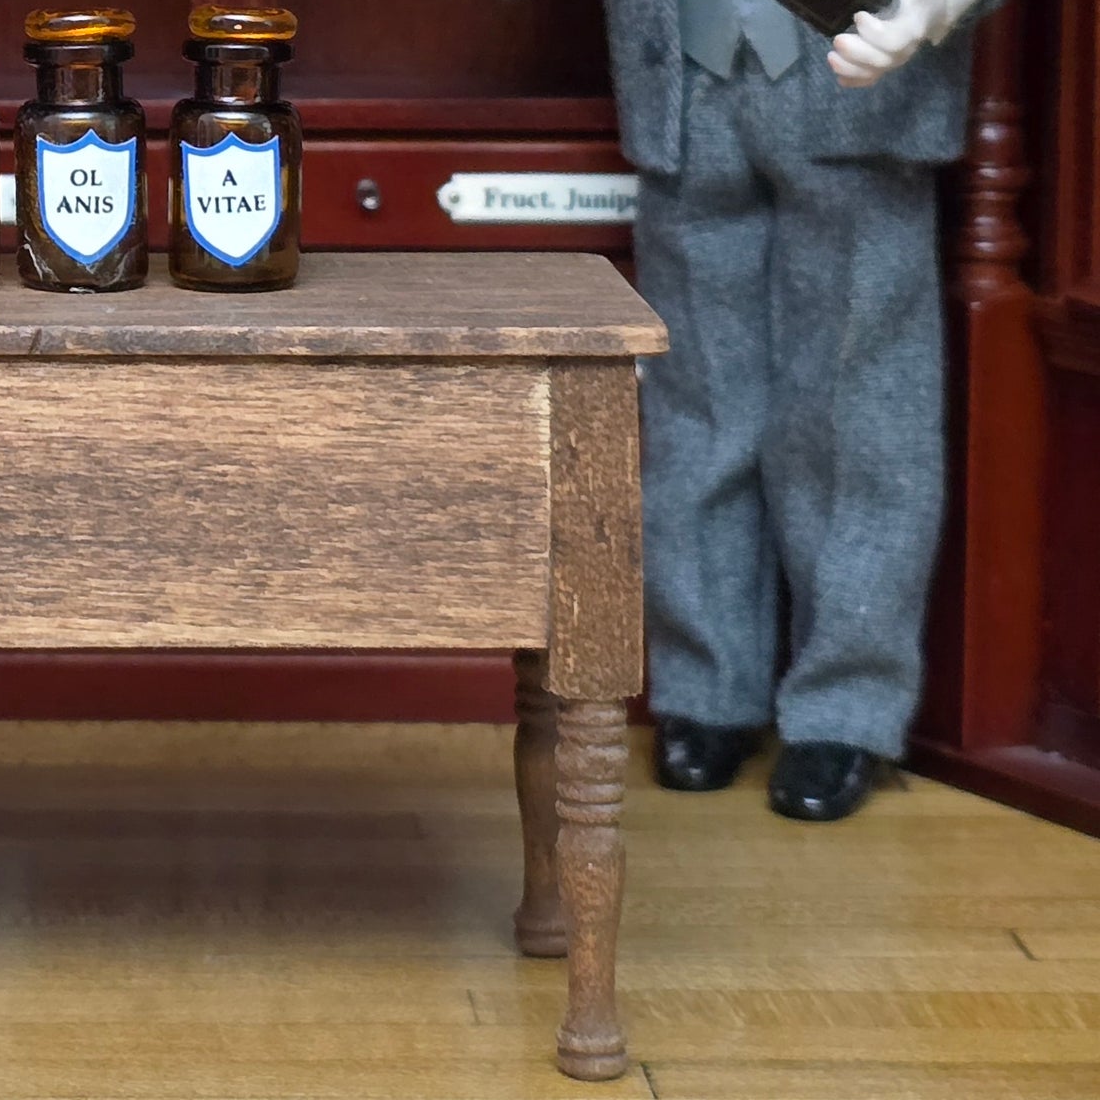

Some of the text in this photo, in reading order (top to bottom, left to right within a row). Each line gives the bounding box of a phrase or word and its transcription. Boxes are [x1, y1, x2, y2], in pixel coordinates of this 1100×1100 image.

[70, 169, 103, 186] OL
[222, 169, 238, 186] A
[57, 196, 114, 214] ANIS
[197, 194, 266, 213] VITAE
[483, 188, 554, 208] Fruct.
